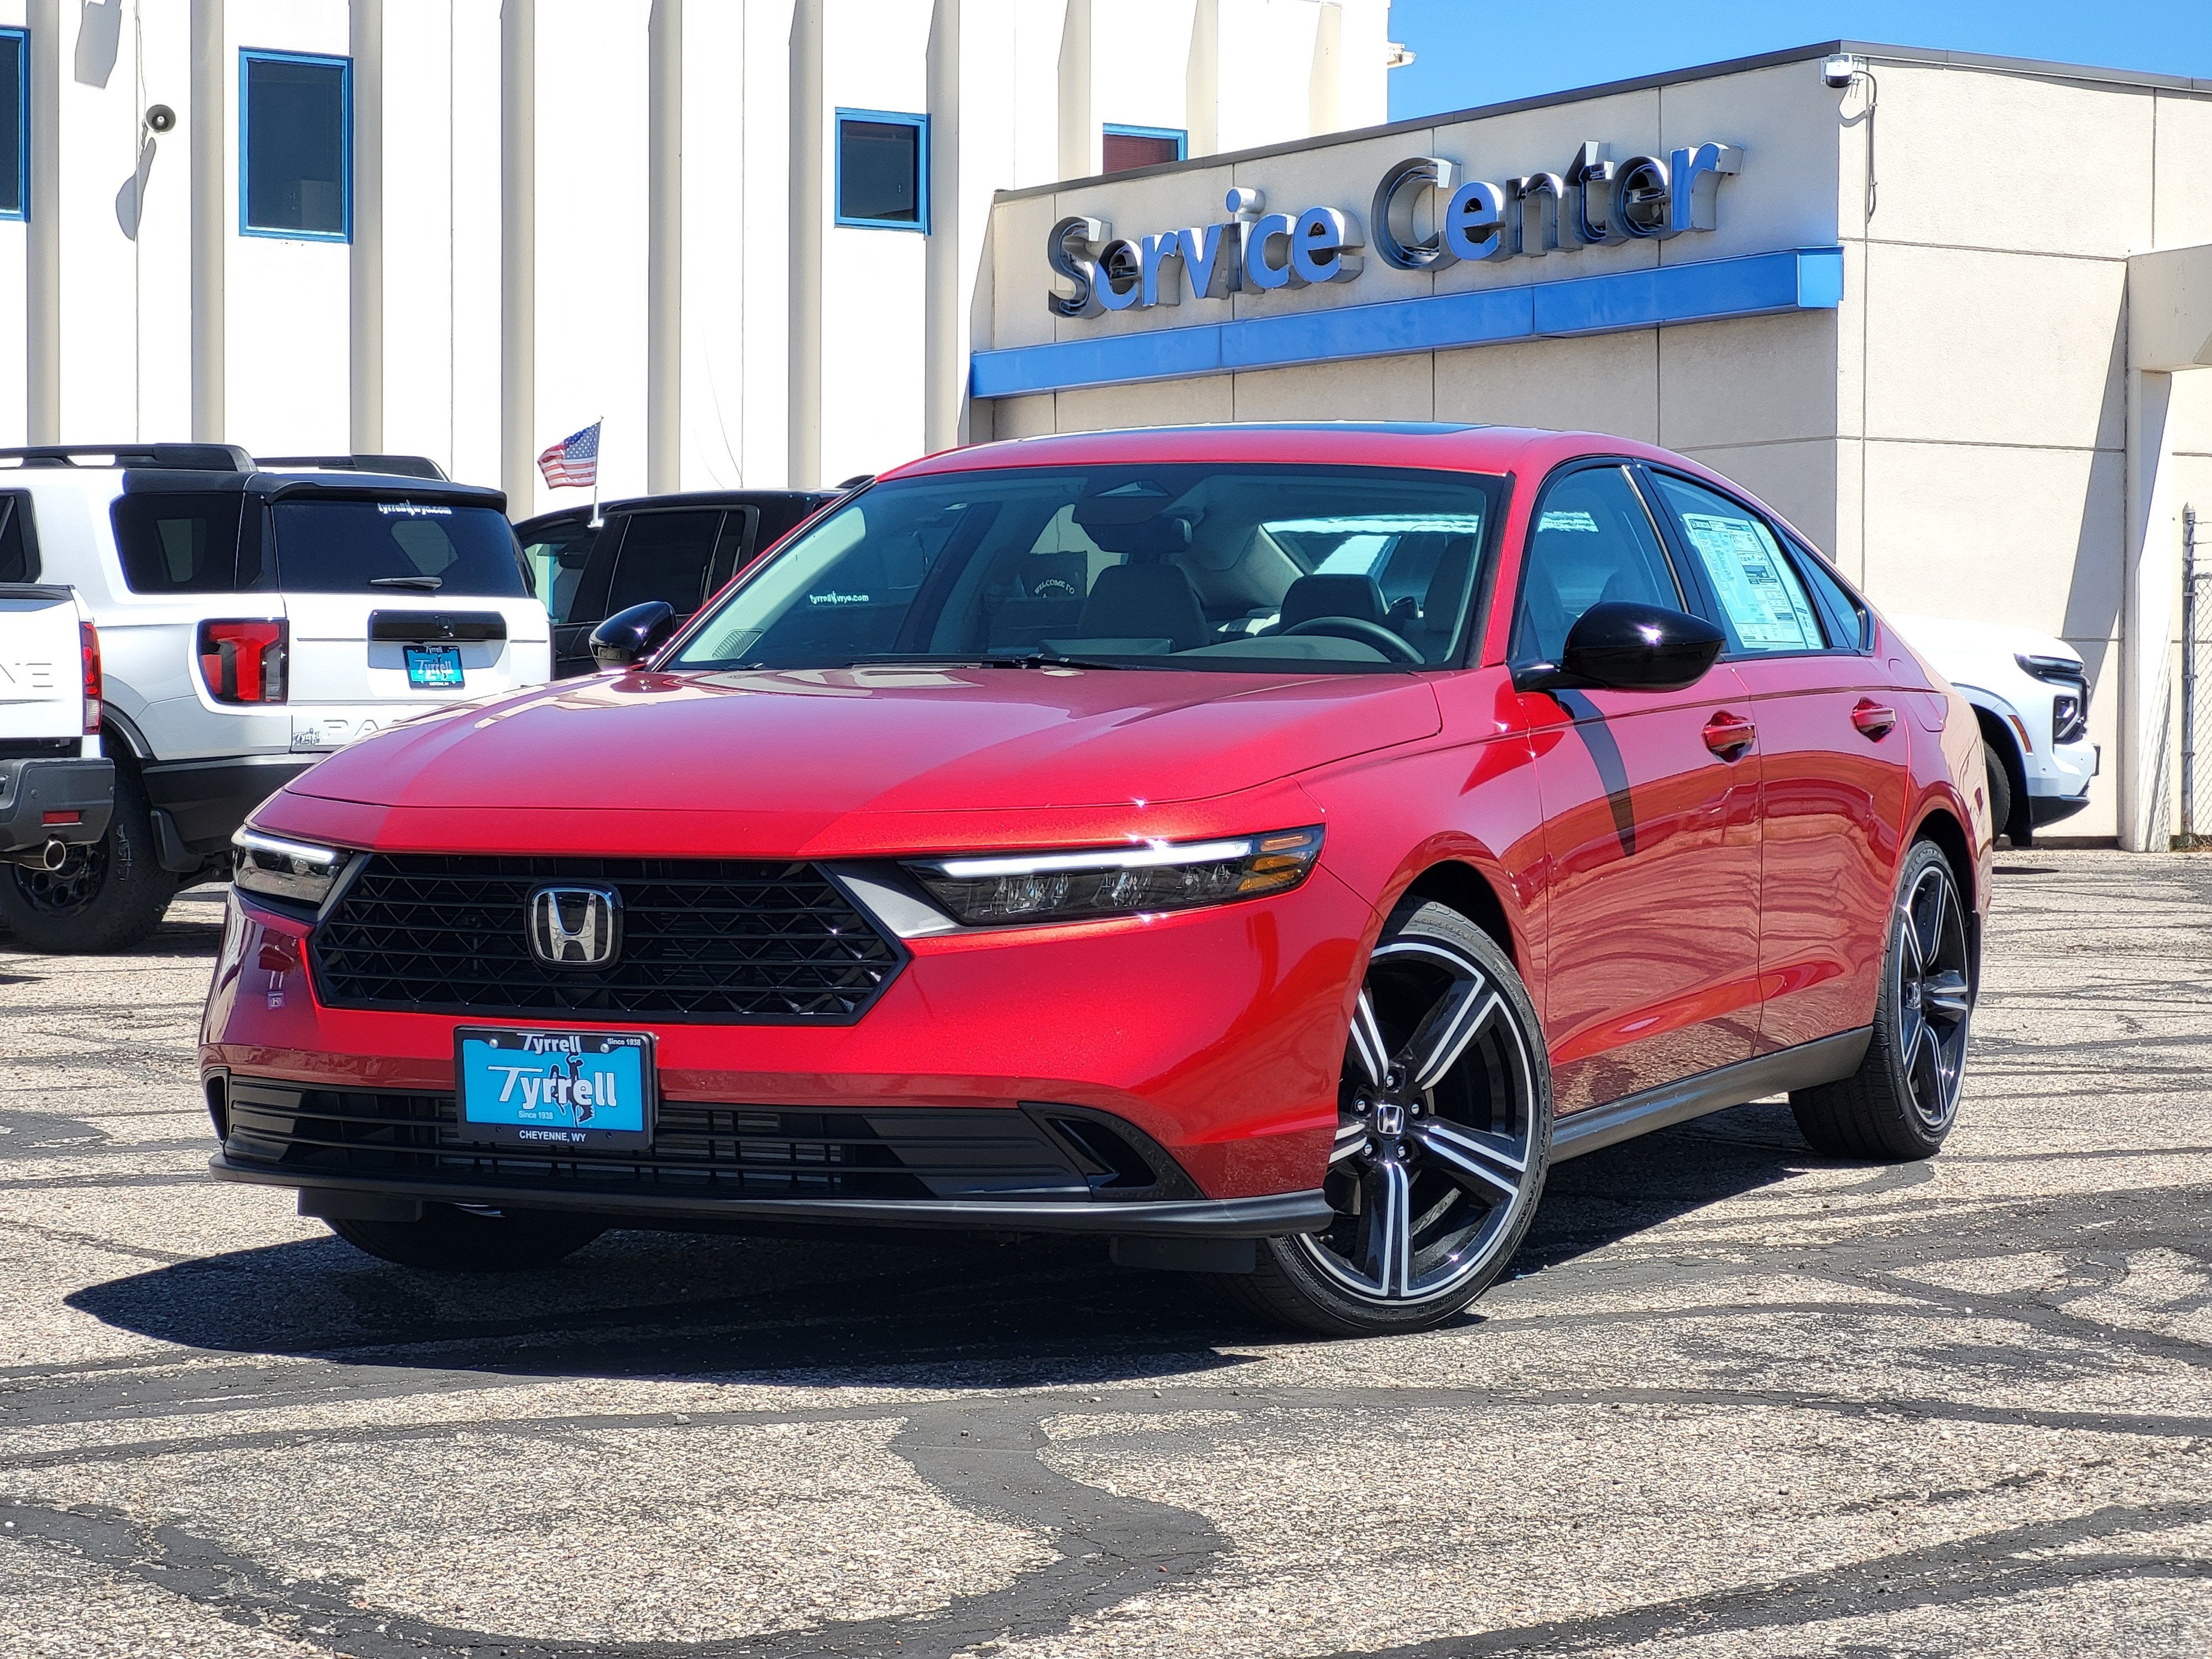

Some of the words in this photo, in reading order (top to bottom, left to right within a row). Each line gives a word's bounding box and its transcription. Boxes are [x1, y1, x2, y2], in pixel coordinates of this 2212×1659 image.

[1047, 187, 1364, 320] Service
[1371, 140, 1746, 272] Center
[517, 1032, 582, 1055] Tyrrell
[487, 1065, 617, 1110] Tyrrell
[518, 1110, 536, 1119] Since
[538, 1112, 553, 1120] 1938
[519, 1130, 570, 1142] CHEYENNE,
[571, 1133, 586, 1142] WY
